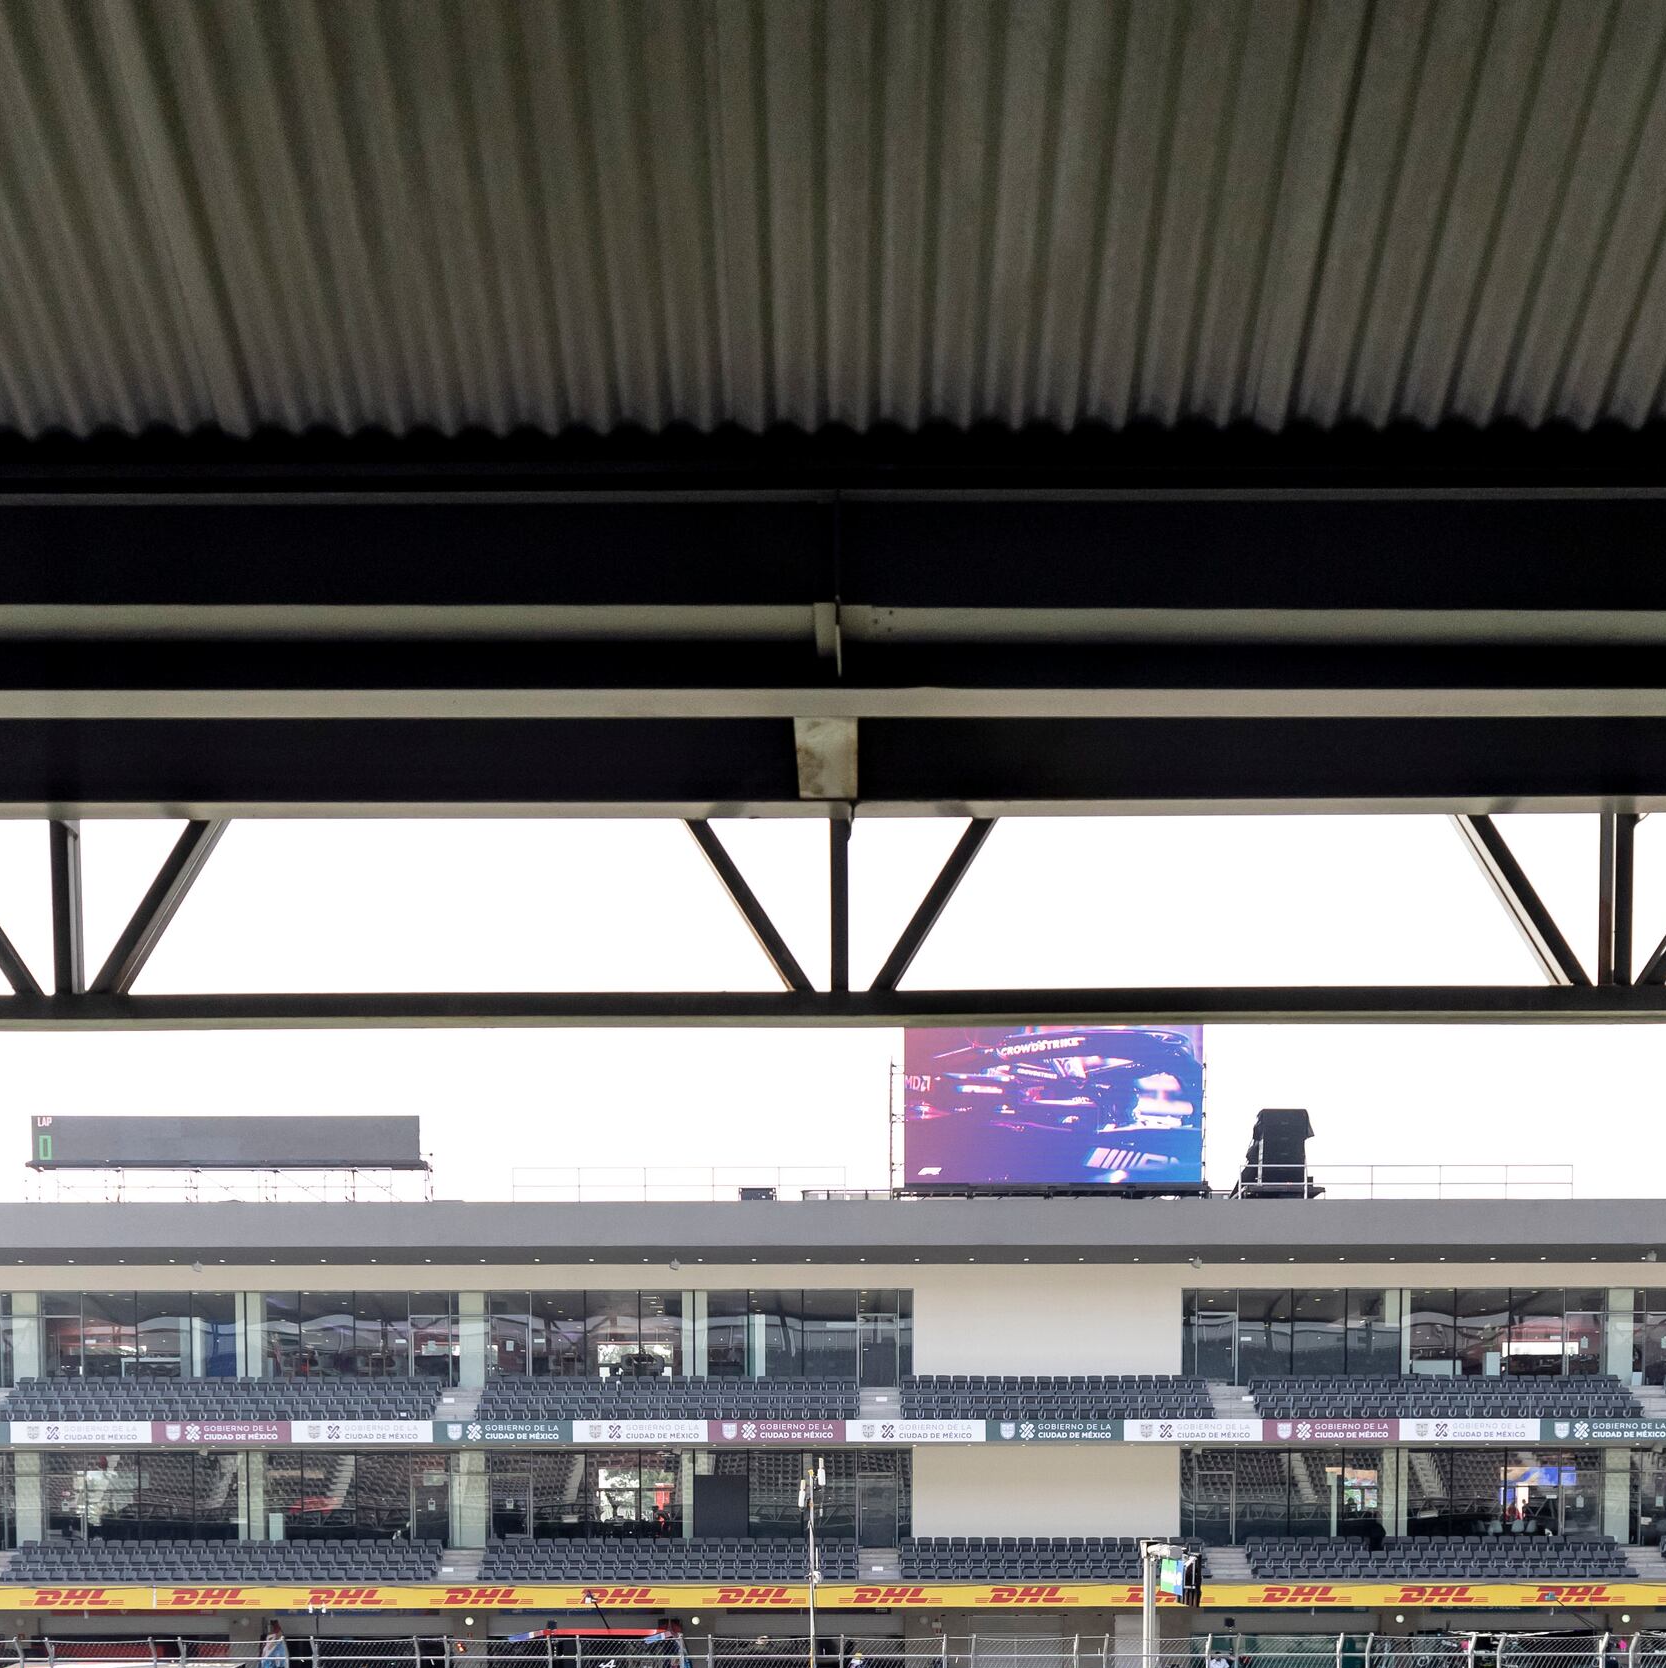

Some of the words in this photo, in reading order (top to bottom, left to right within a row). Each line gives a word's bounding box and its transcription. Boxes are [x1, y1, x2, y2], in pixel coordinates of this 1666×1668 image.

[37, 1117, 52, 1127] LAP
[485, 1424, 532, 1432] GOBIERNO
[534, 1424, 545, 1432] DE
[548, 1424, 560, 1432] LA
[760, 1423, 806, 1431] GOBIERNO
[808, 1423, 820, 1431] DE
[822, 1423, 834, 1431] LA
[1038, 1423, 1084, 1431] GOBIERNO
[1086, 1423, 1098, 1431] DE
[1100, 1423, 1112, 1431] LA
[1315, 1431, 1345, 1439] CIUDAD
[1346, 1431, 1357, 1439] DE
[1358, 1430, 1389, 1439] MÉXICO
[1636, 1430, 1666, 1438] MÉXICO
[203, 1433, 234, 1441] CIUDAD
[235, 1433, 246, 1441] DE
[248, 1432, 278, 1441] MÉXICO
[529, 1432, 560, 1440] MÉXICO
[803, 1431, 834, 1439] MÉXICO
[1081, 1431, 1112, 1439] MÉXICO
[34, 1590, 108, 1606] DHL
[171, 1589, 245, 1606] DHL
[308, 1589, 382, 1606] DHL
[444, 1589, 518, 1604] DHL
[582, 1589, 656, 1604] DHL
[718, 1588, 792, 1604] DHL
[853, 1588, 927, 1604] DHL
[990, 1588, 1064, 1604] DHL
[1262, 1587, 1336, 1604] DHL
[1398, 1587, 1472, 1604] DHL
[1536, 1587, 1610, 1602] DHL
